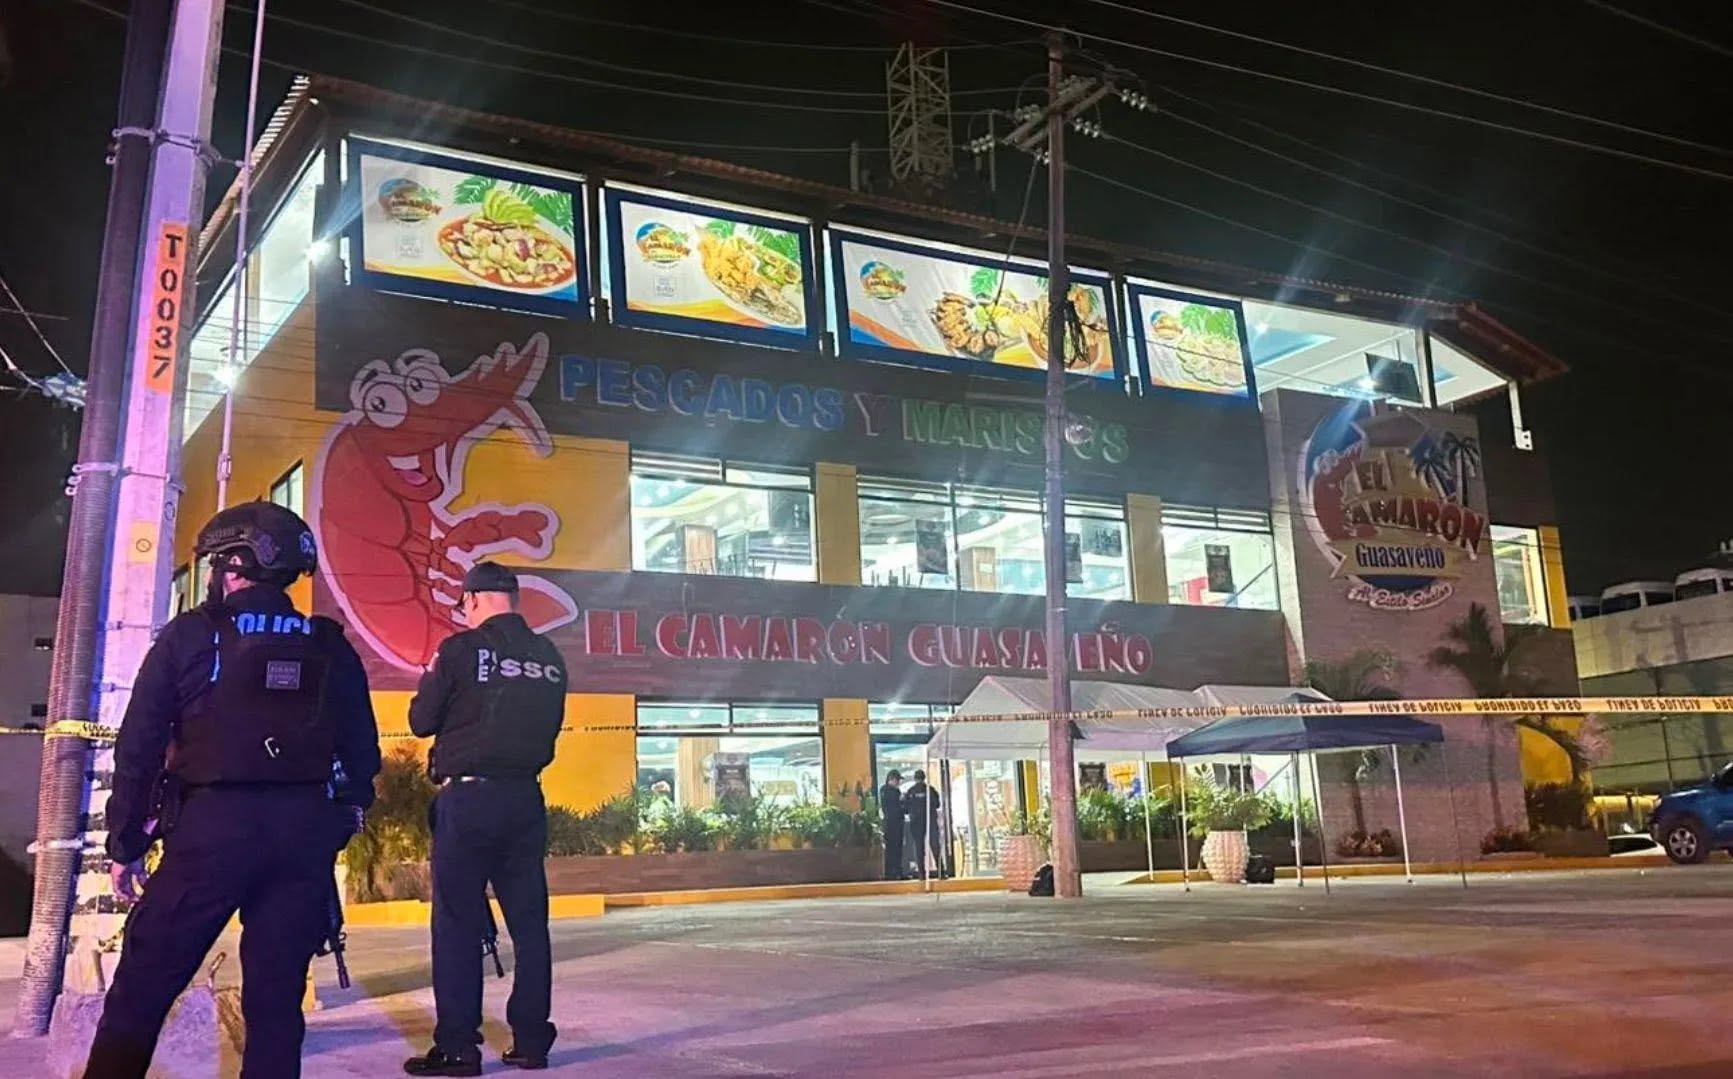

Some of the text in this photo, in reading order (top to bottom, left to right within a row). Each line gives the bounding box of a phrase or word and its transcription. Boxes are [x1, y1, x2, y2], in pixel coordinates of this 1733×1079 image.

[152, 233, 183, 380] T0037
[559, 355, 1130, 465] PESCADOS Y MARISOS
[1353, 460, 1390, 492] EL
[499, 658, 561, 684] SSC
[583, 605, 1155, 676] EL CAMARÓN GUASAEÑO
